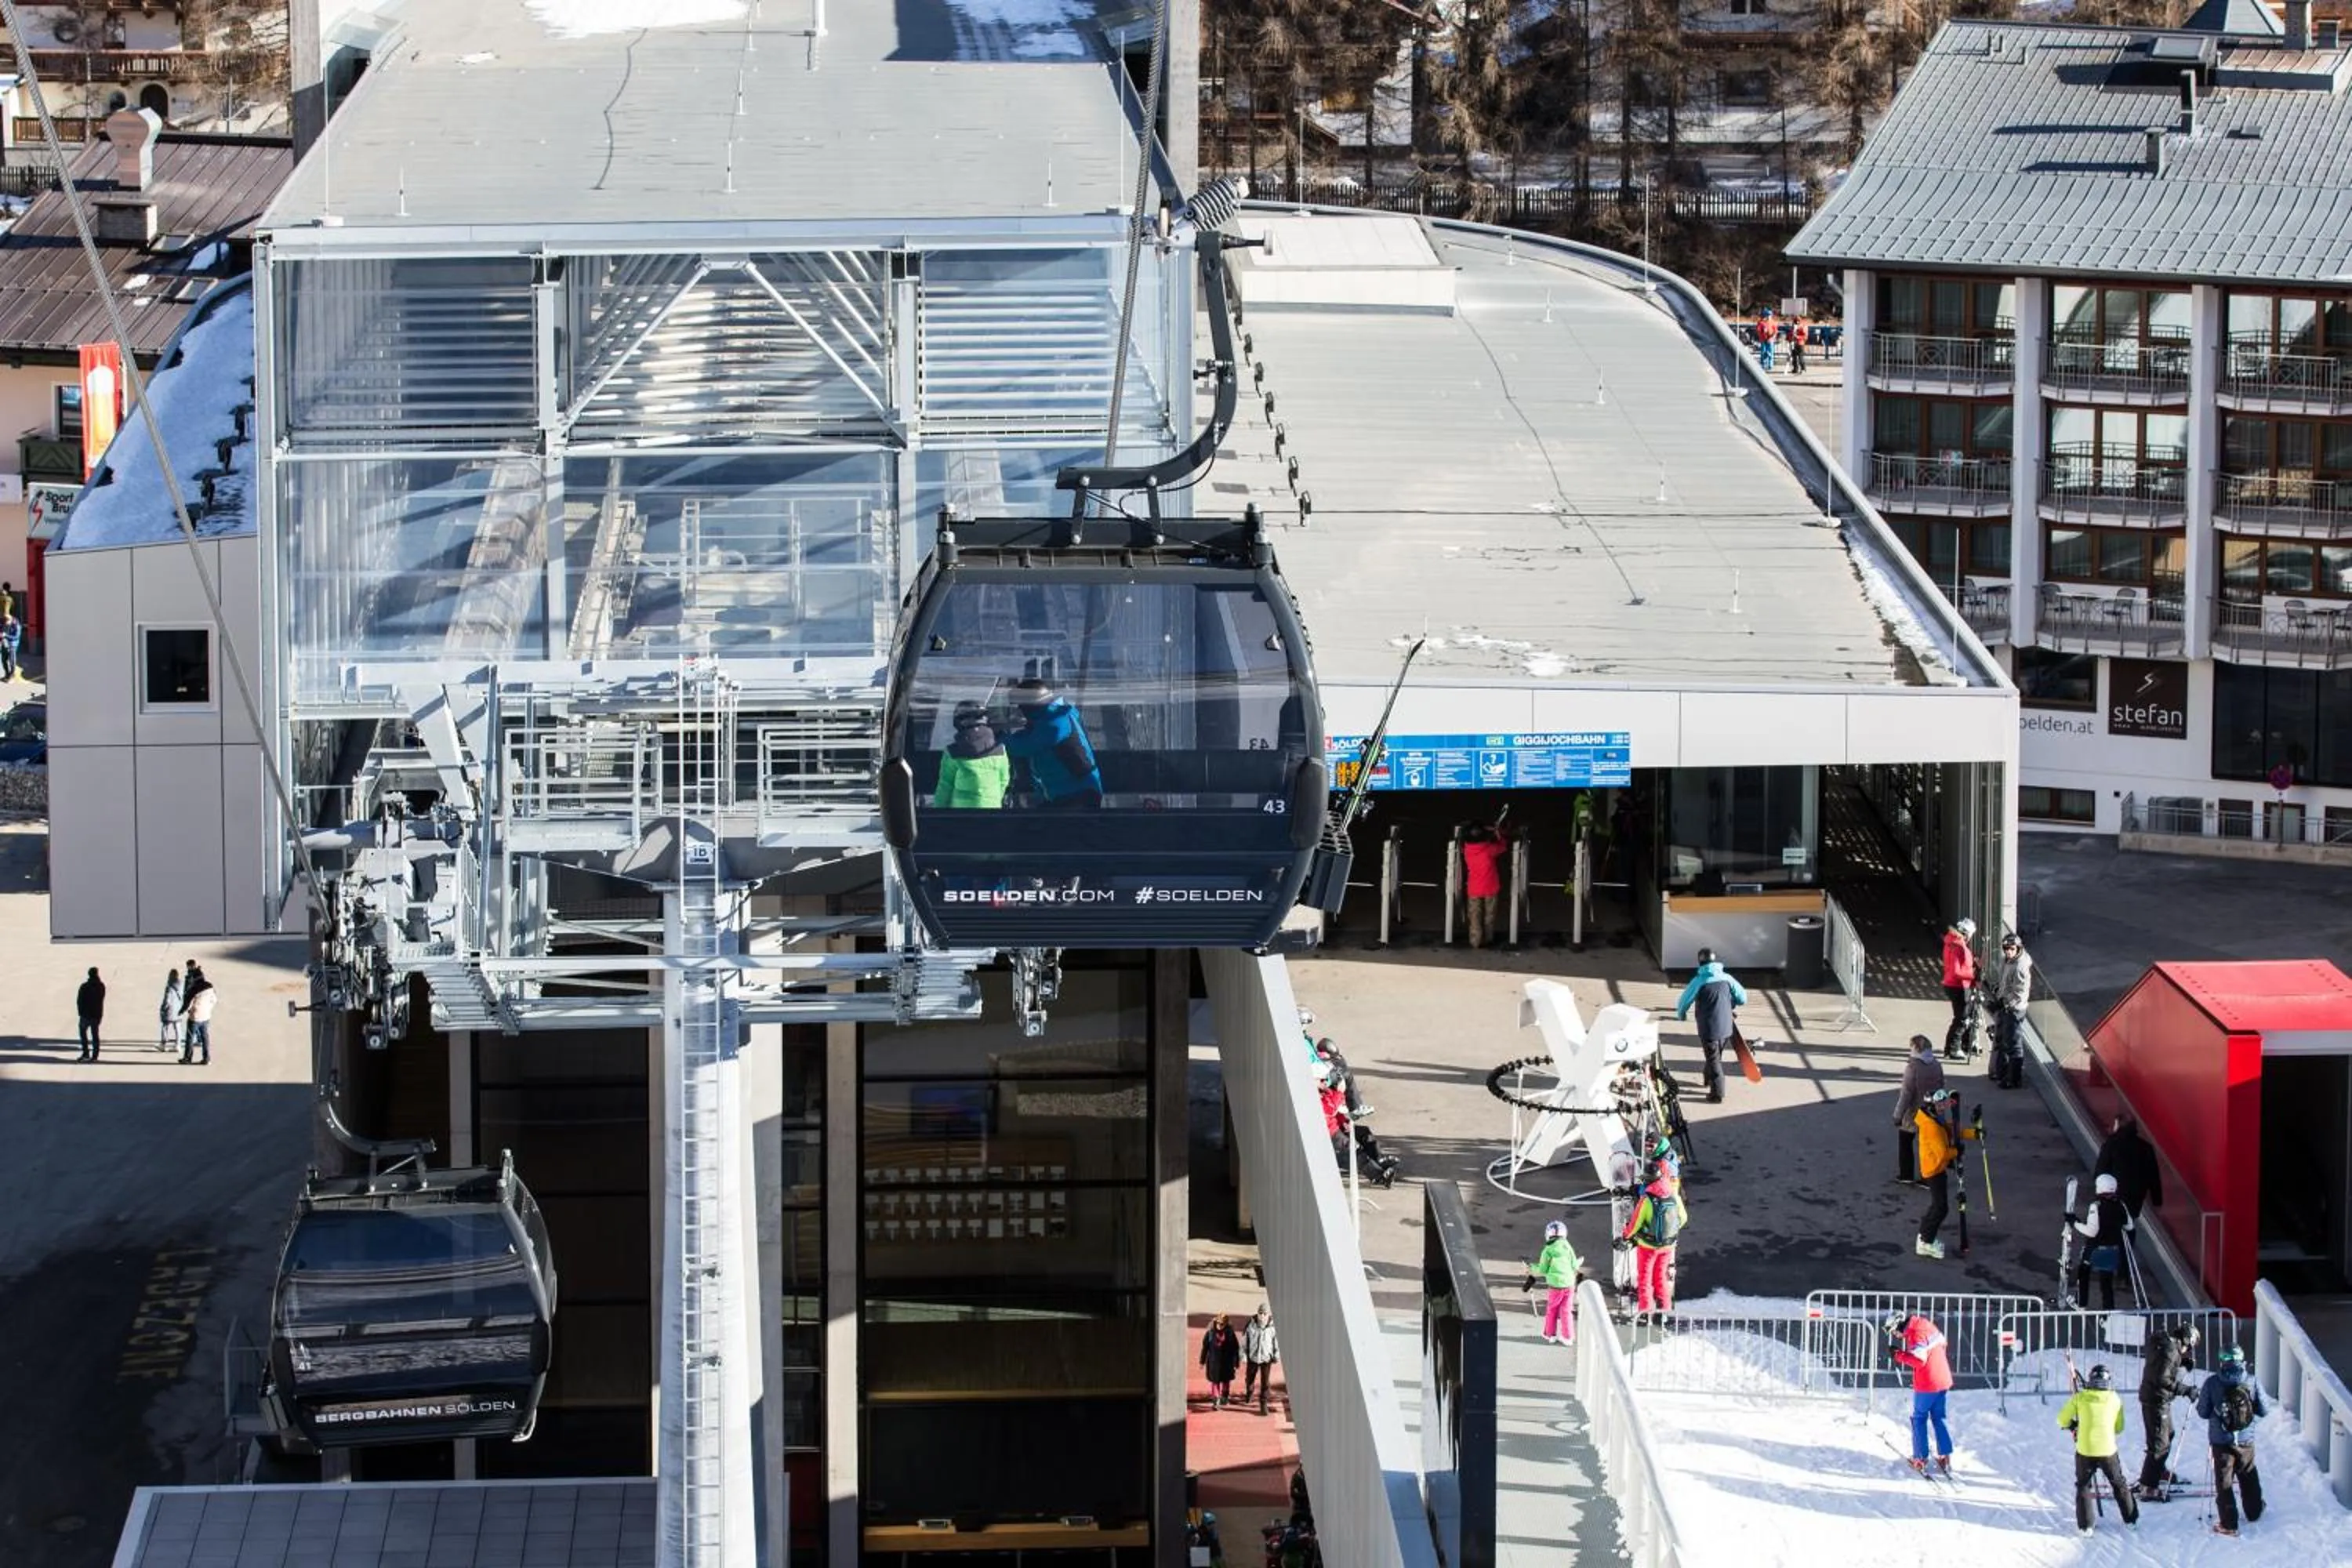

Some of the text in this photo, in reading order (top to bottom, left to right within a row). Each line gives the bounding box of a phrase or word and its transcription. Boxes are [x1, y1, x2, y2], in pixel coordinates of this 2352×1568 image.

[2114, 703, 2183, 725] stefan
[1513, 735, 1606, 745] GIGGIJOCHBAHN
[1263, 800, 1285, 813] 43
[943, 886, 1263, 904] SOELDEN.COM #SOELDEN
[315, 1400, 517, 1423] BERGBAHNEN SÖLDEN
